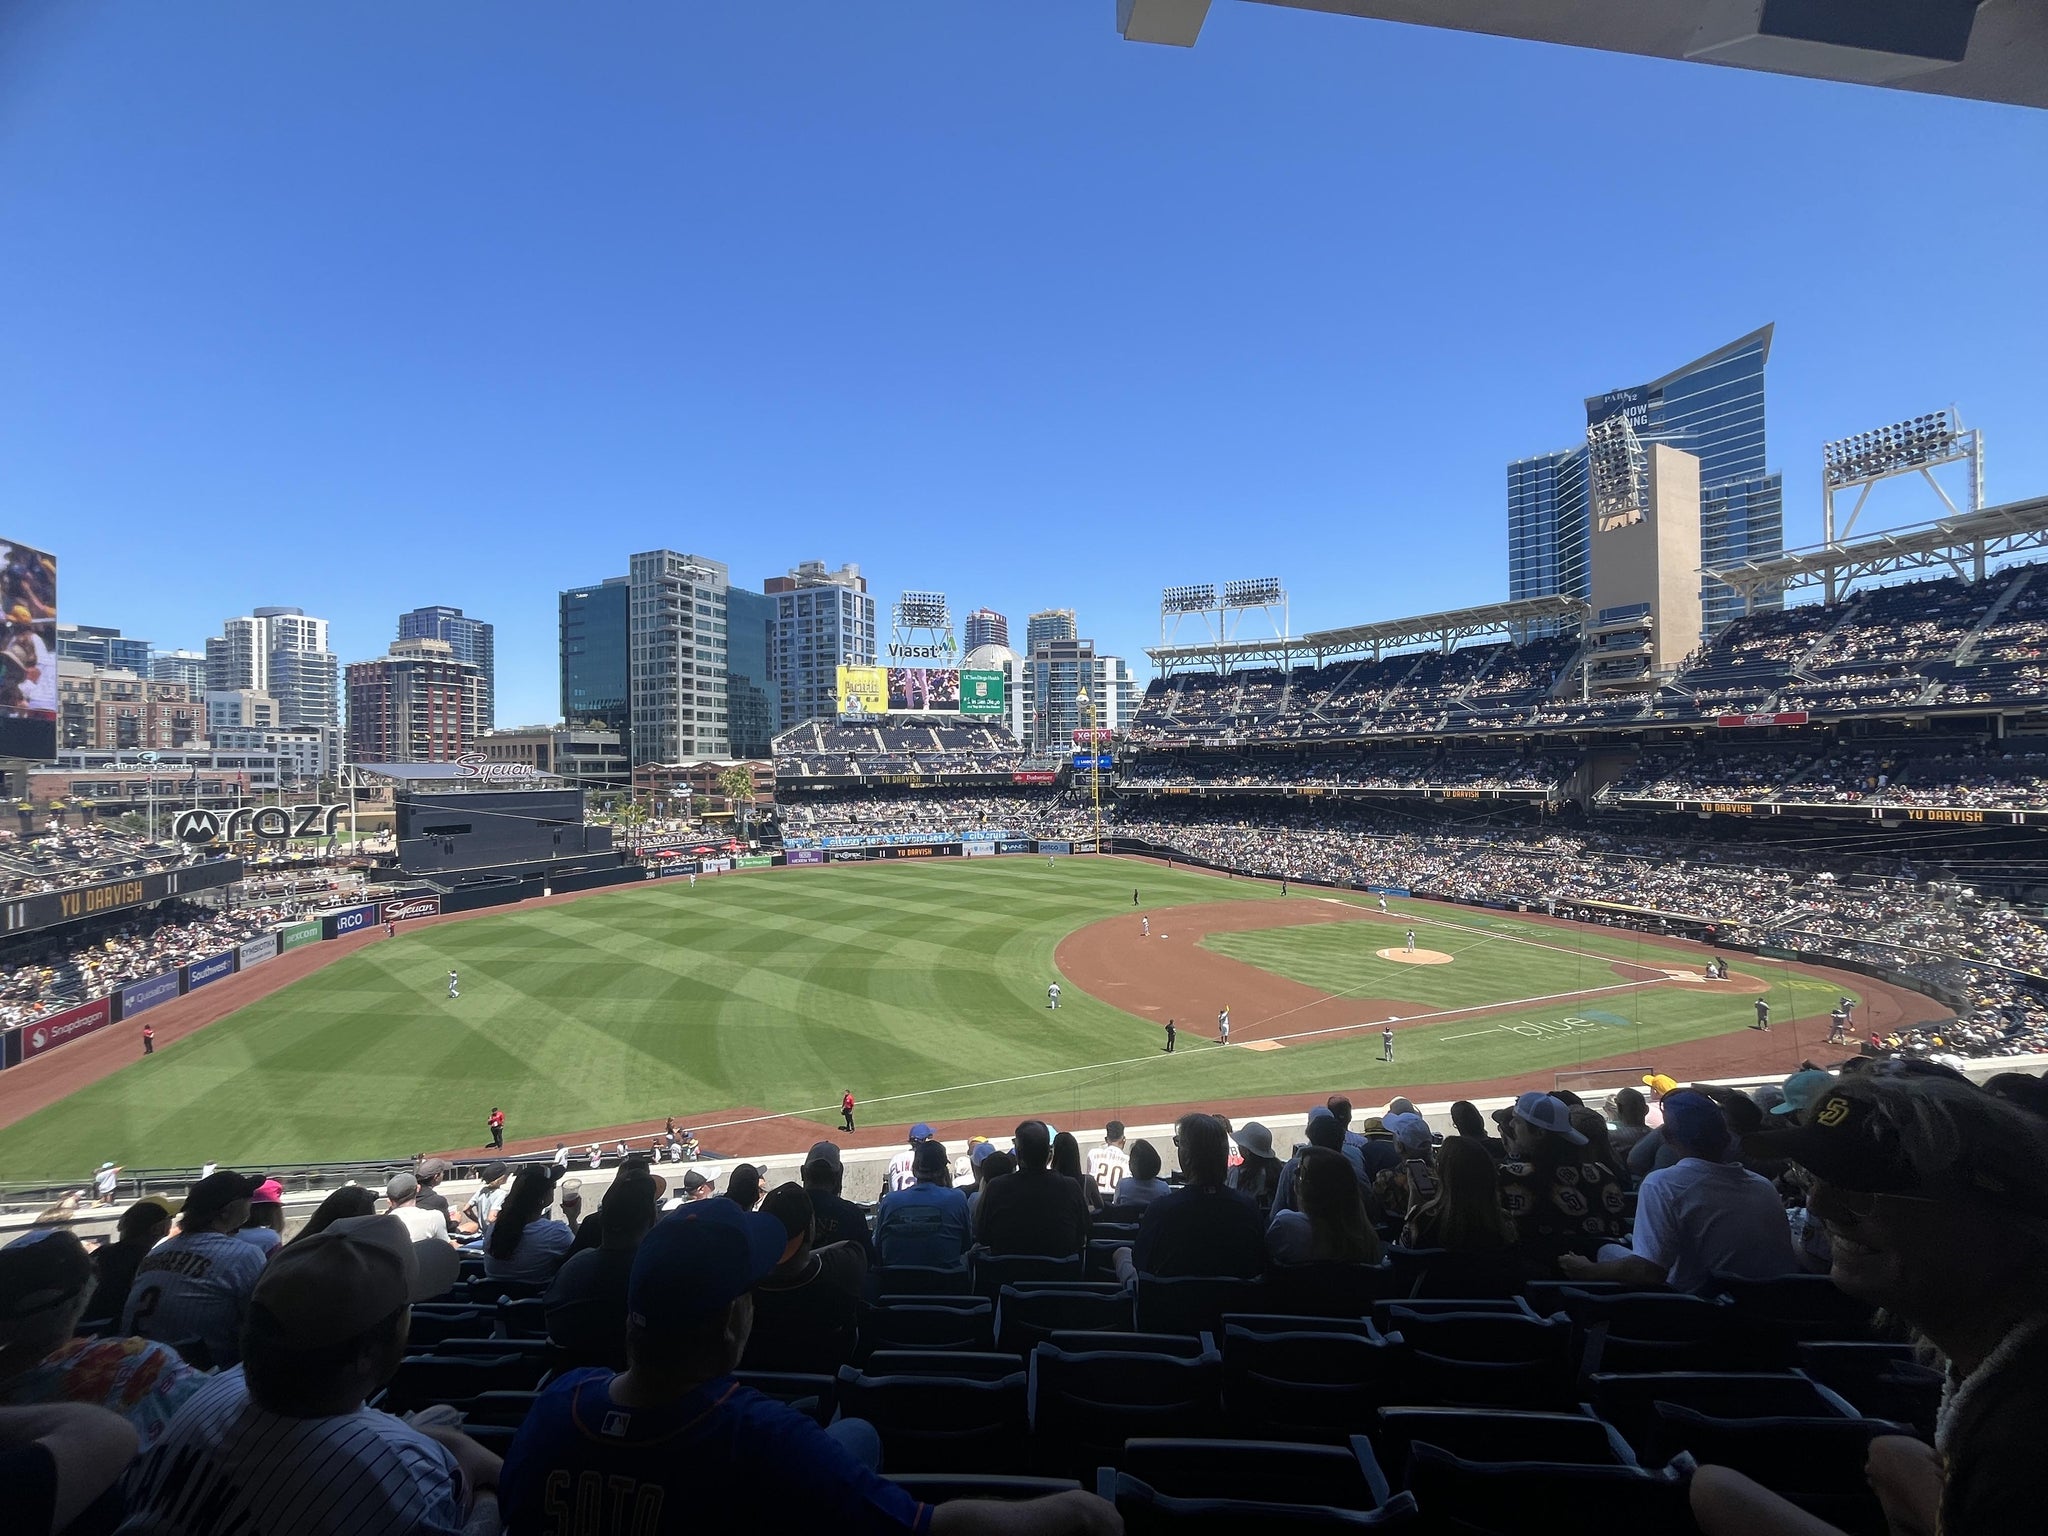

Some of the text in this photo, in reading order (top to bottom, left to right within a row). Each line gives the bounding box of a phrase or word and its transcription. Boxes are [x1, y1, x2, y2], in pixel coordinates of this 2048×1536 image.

[1604, 392, 1638, 403] PARK 12
[1623, 404, 1647, 417] NOW
[888, 643, 937, 658] Viasat
[157, 763, 193, 772] Square
[454, 753, 537, 783] Sycuan
[881, 776, 890, 784] YU
[893, 775, 920, 784] DARVISH
[1701, 803, 1712, 812] YU
[1714, 803, 1752, 813] DARVISH
[1908, 809, 1923, 820] YU
[1928, 810, 1983, 822] DARVISH
[224, 803, 350, 842] razr
[897, 849, 906, 857] YU
[907, 848, 932, 856] DARVISH
[1040, 844, 1059, 852] petco
[167, 873, 178, 894] 11
[61, 881, 143, 917] YU DARVISH
[8, 903, 25, 930] 11
[385, 901, 435, 919] Sycuan
[192, 960, 228, 983] Southwest
[51, 1011, 103, 1038] Snapdragon
[1817, 1098, 1850, 1127] SD
[1096, 1162, 1123, 1190] 20
[544, 1469, 664, 1536] SOTO
